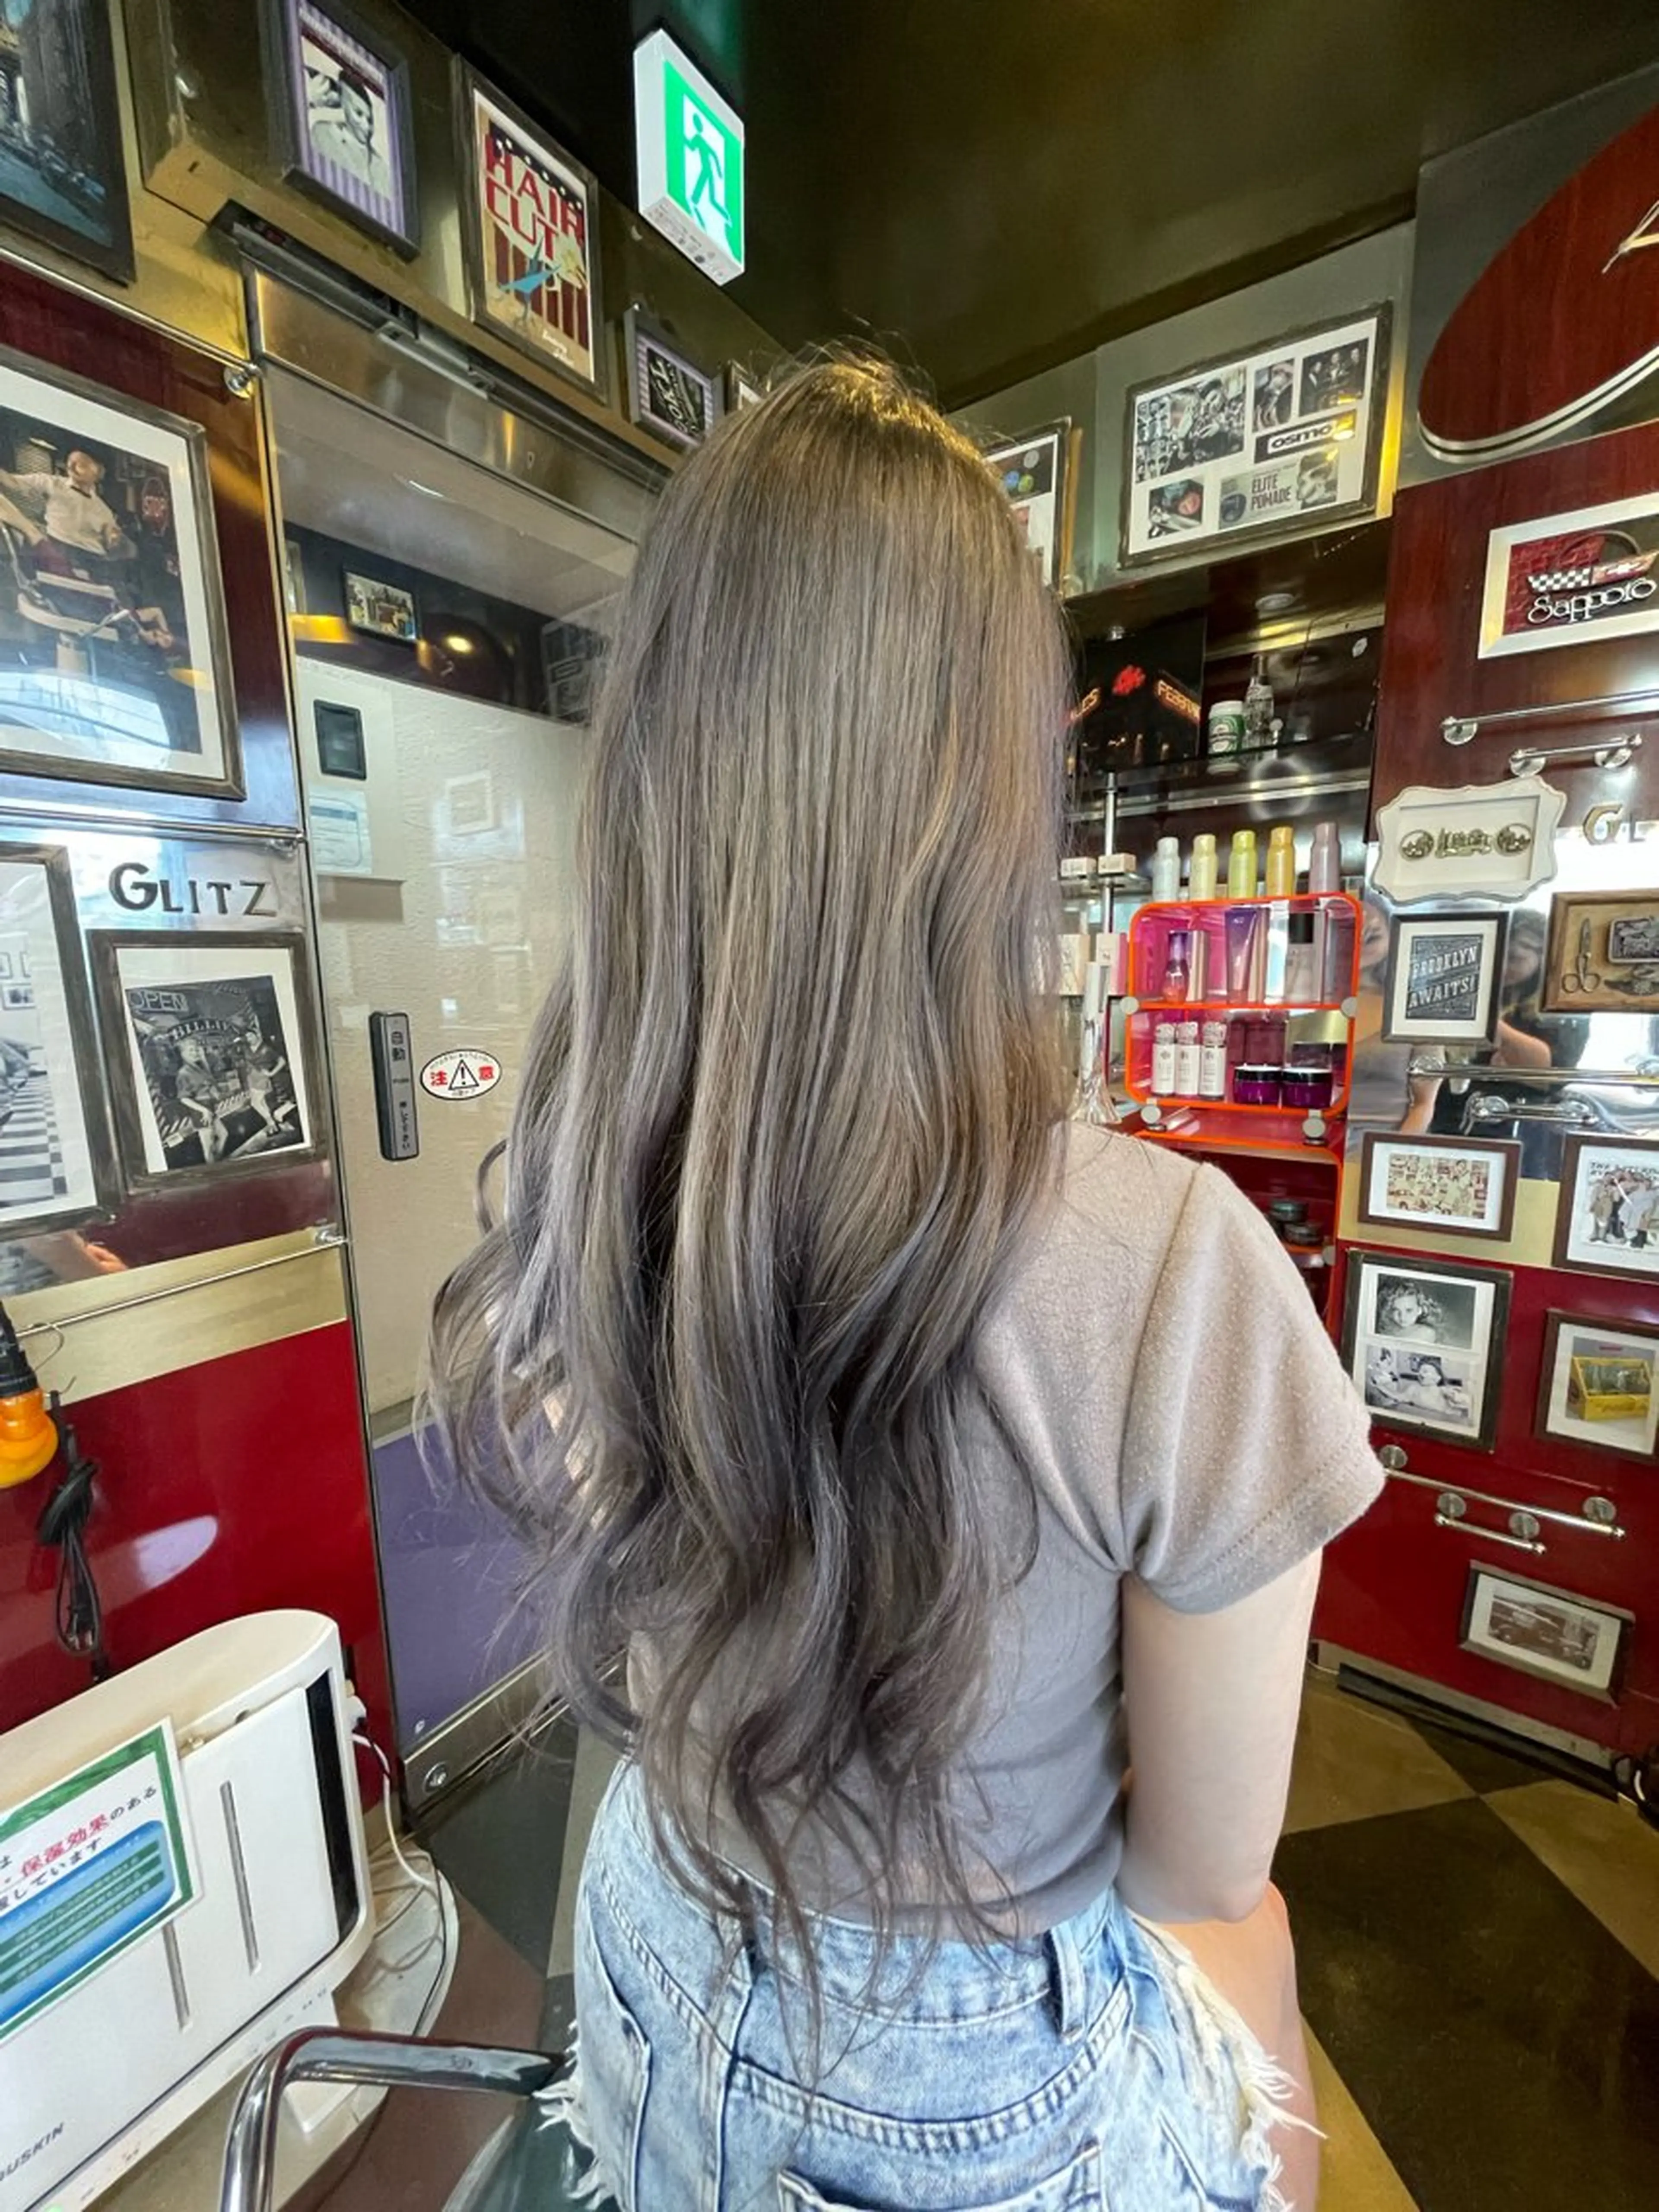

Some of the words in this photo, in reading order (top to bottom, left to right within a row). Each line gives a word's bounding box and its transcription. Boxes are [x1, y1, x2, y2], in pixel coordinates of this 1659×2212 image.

[484, 133, 585, 247] HAIR
[486, 176, 558, 261] CUT
[1271, 424, 1332, 449] osmo
[1252, 474, 1278, 494] ELITE
[108, 862, 278, 917] GLITZ
[1411, 946, 1478, 980] BROOKLYN
[129, 989, 189, 1011] OPEN
